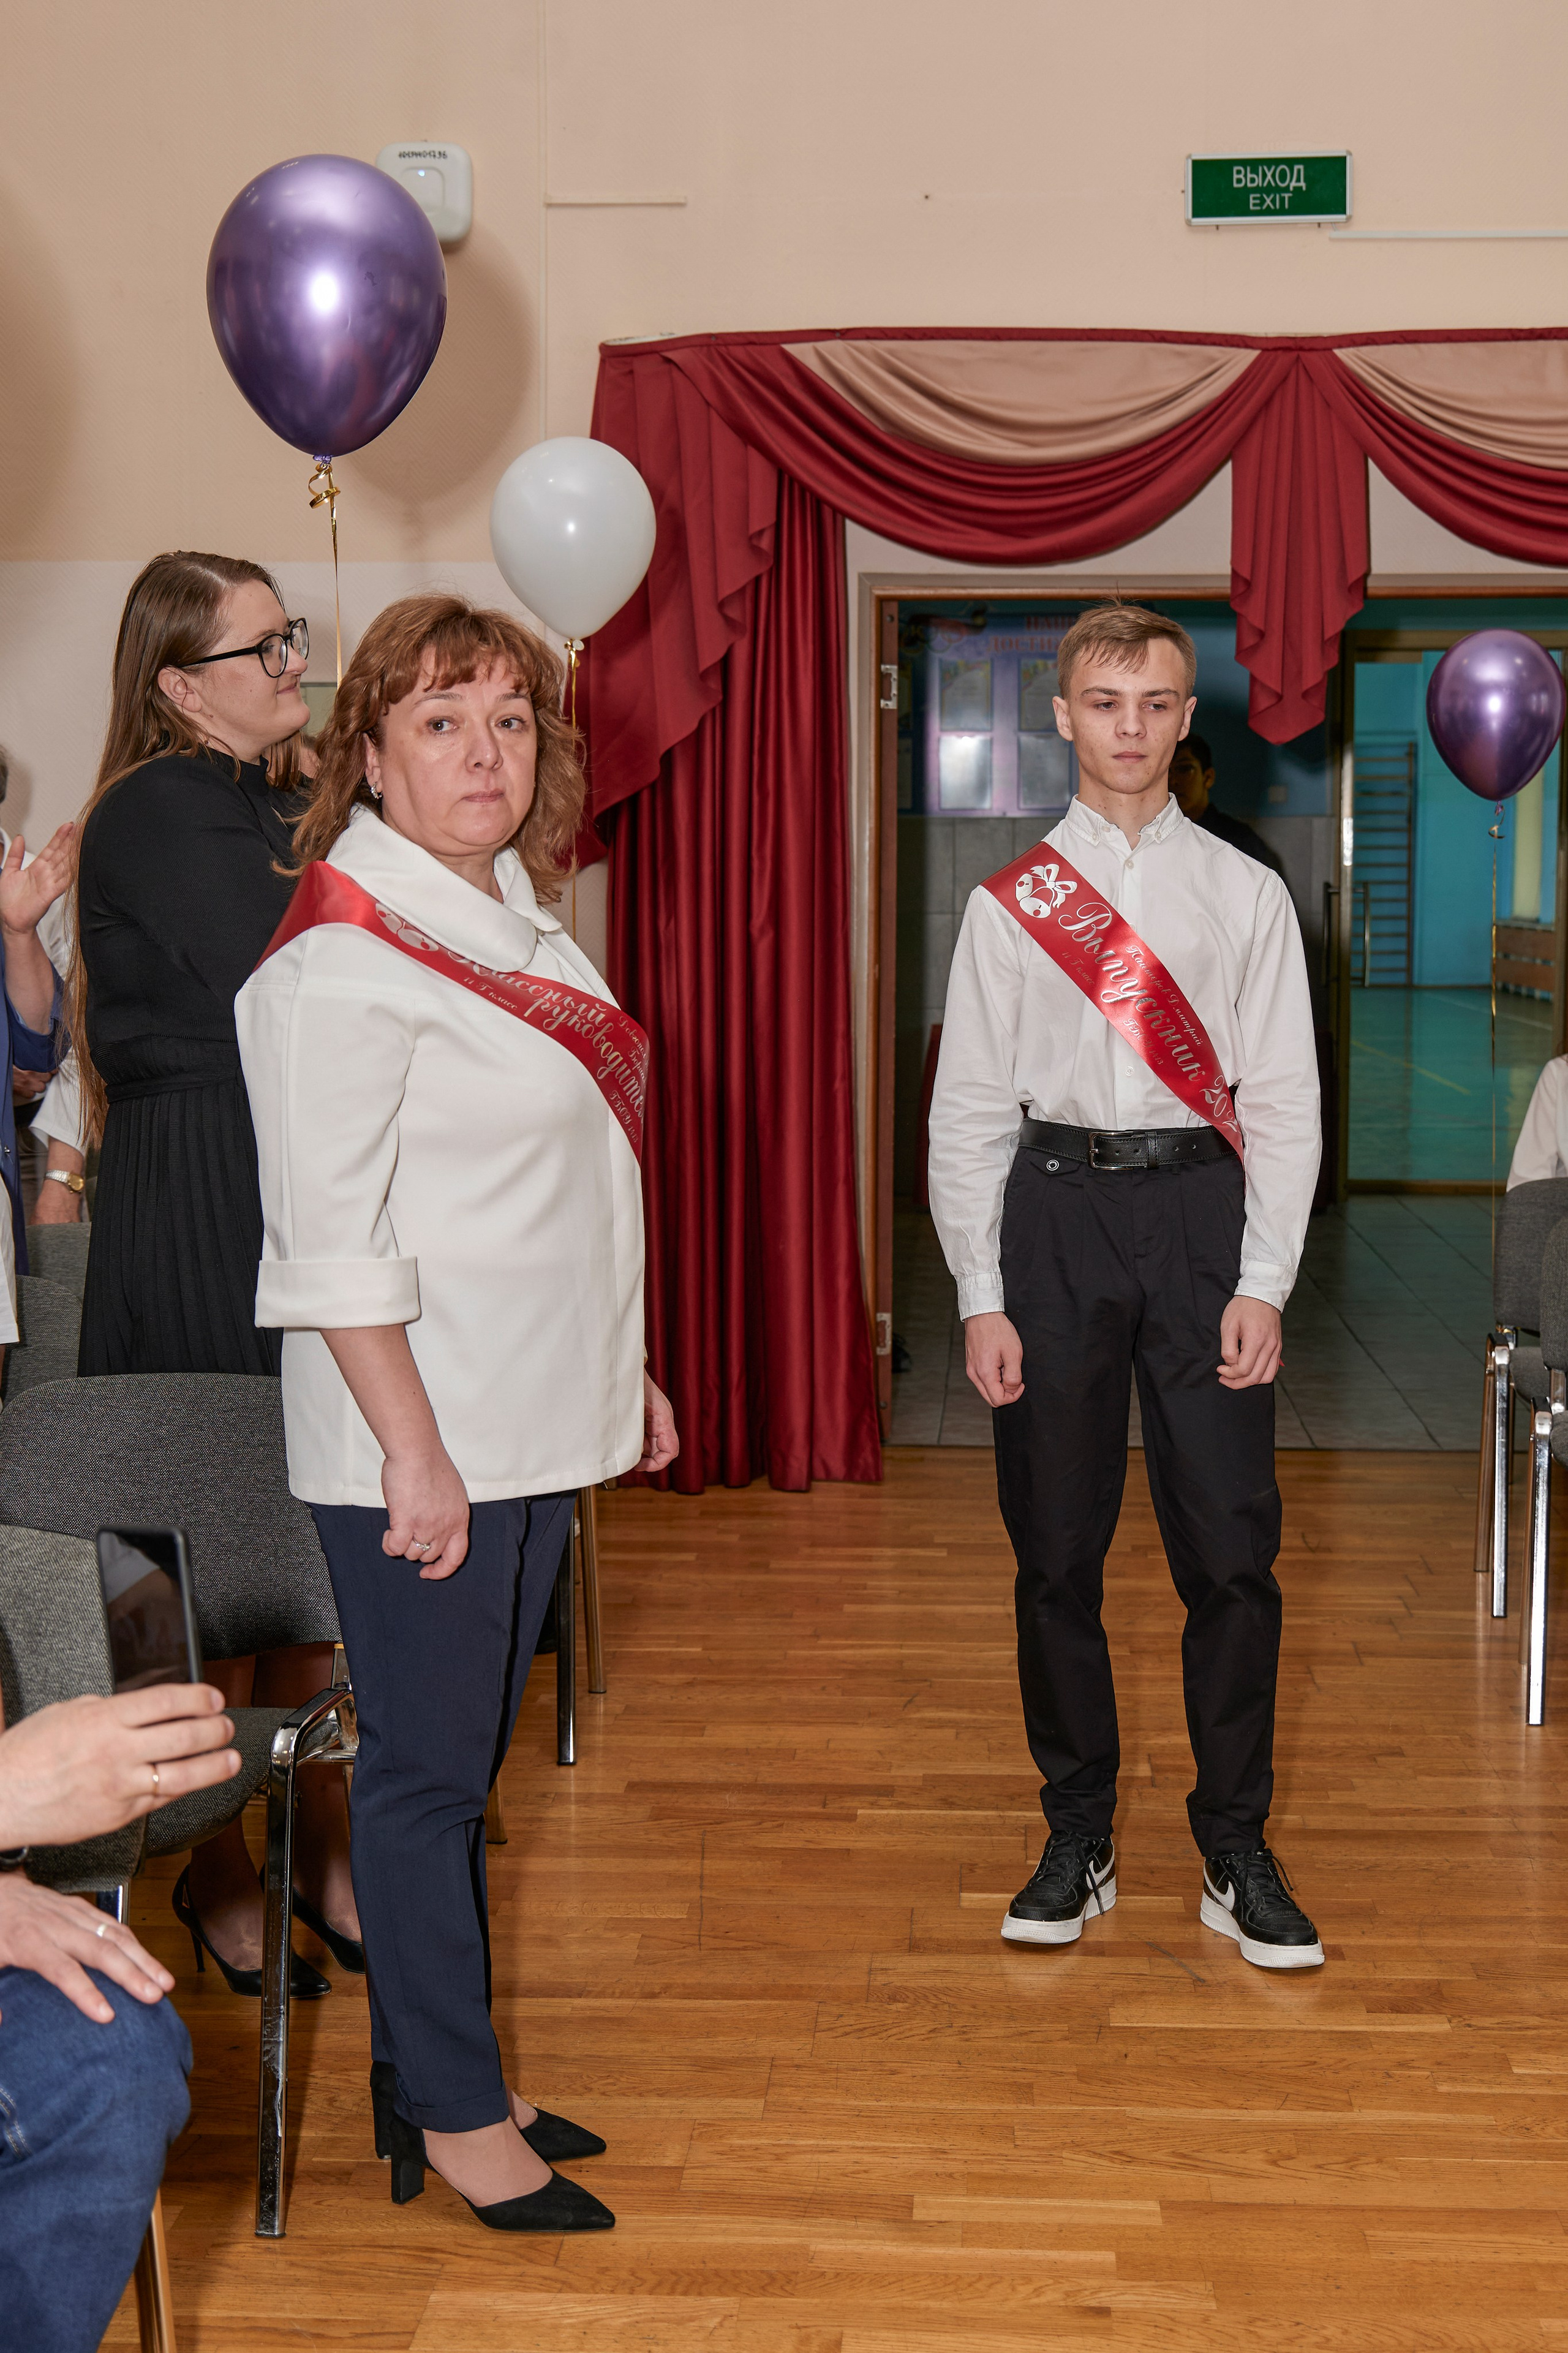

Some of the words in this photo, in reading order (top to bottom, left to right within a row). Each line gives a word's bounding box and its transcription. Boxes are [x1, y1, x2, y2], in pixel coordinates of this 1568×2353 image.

[1232, 165, 1306, 191] ВЫХОД
[1249, 193, 1293, 210] EXIT
[488, 991, 518, 1010] класс
[1058, 902, 1205, 1082] Выпускник
[1166, 994, 1203, 1046] Дмитрий
[610, 1090, 631, 1124] ГБОУ
